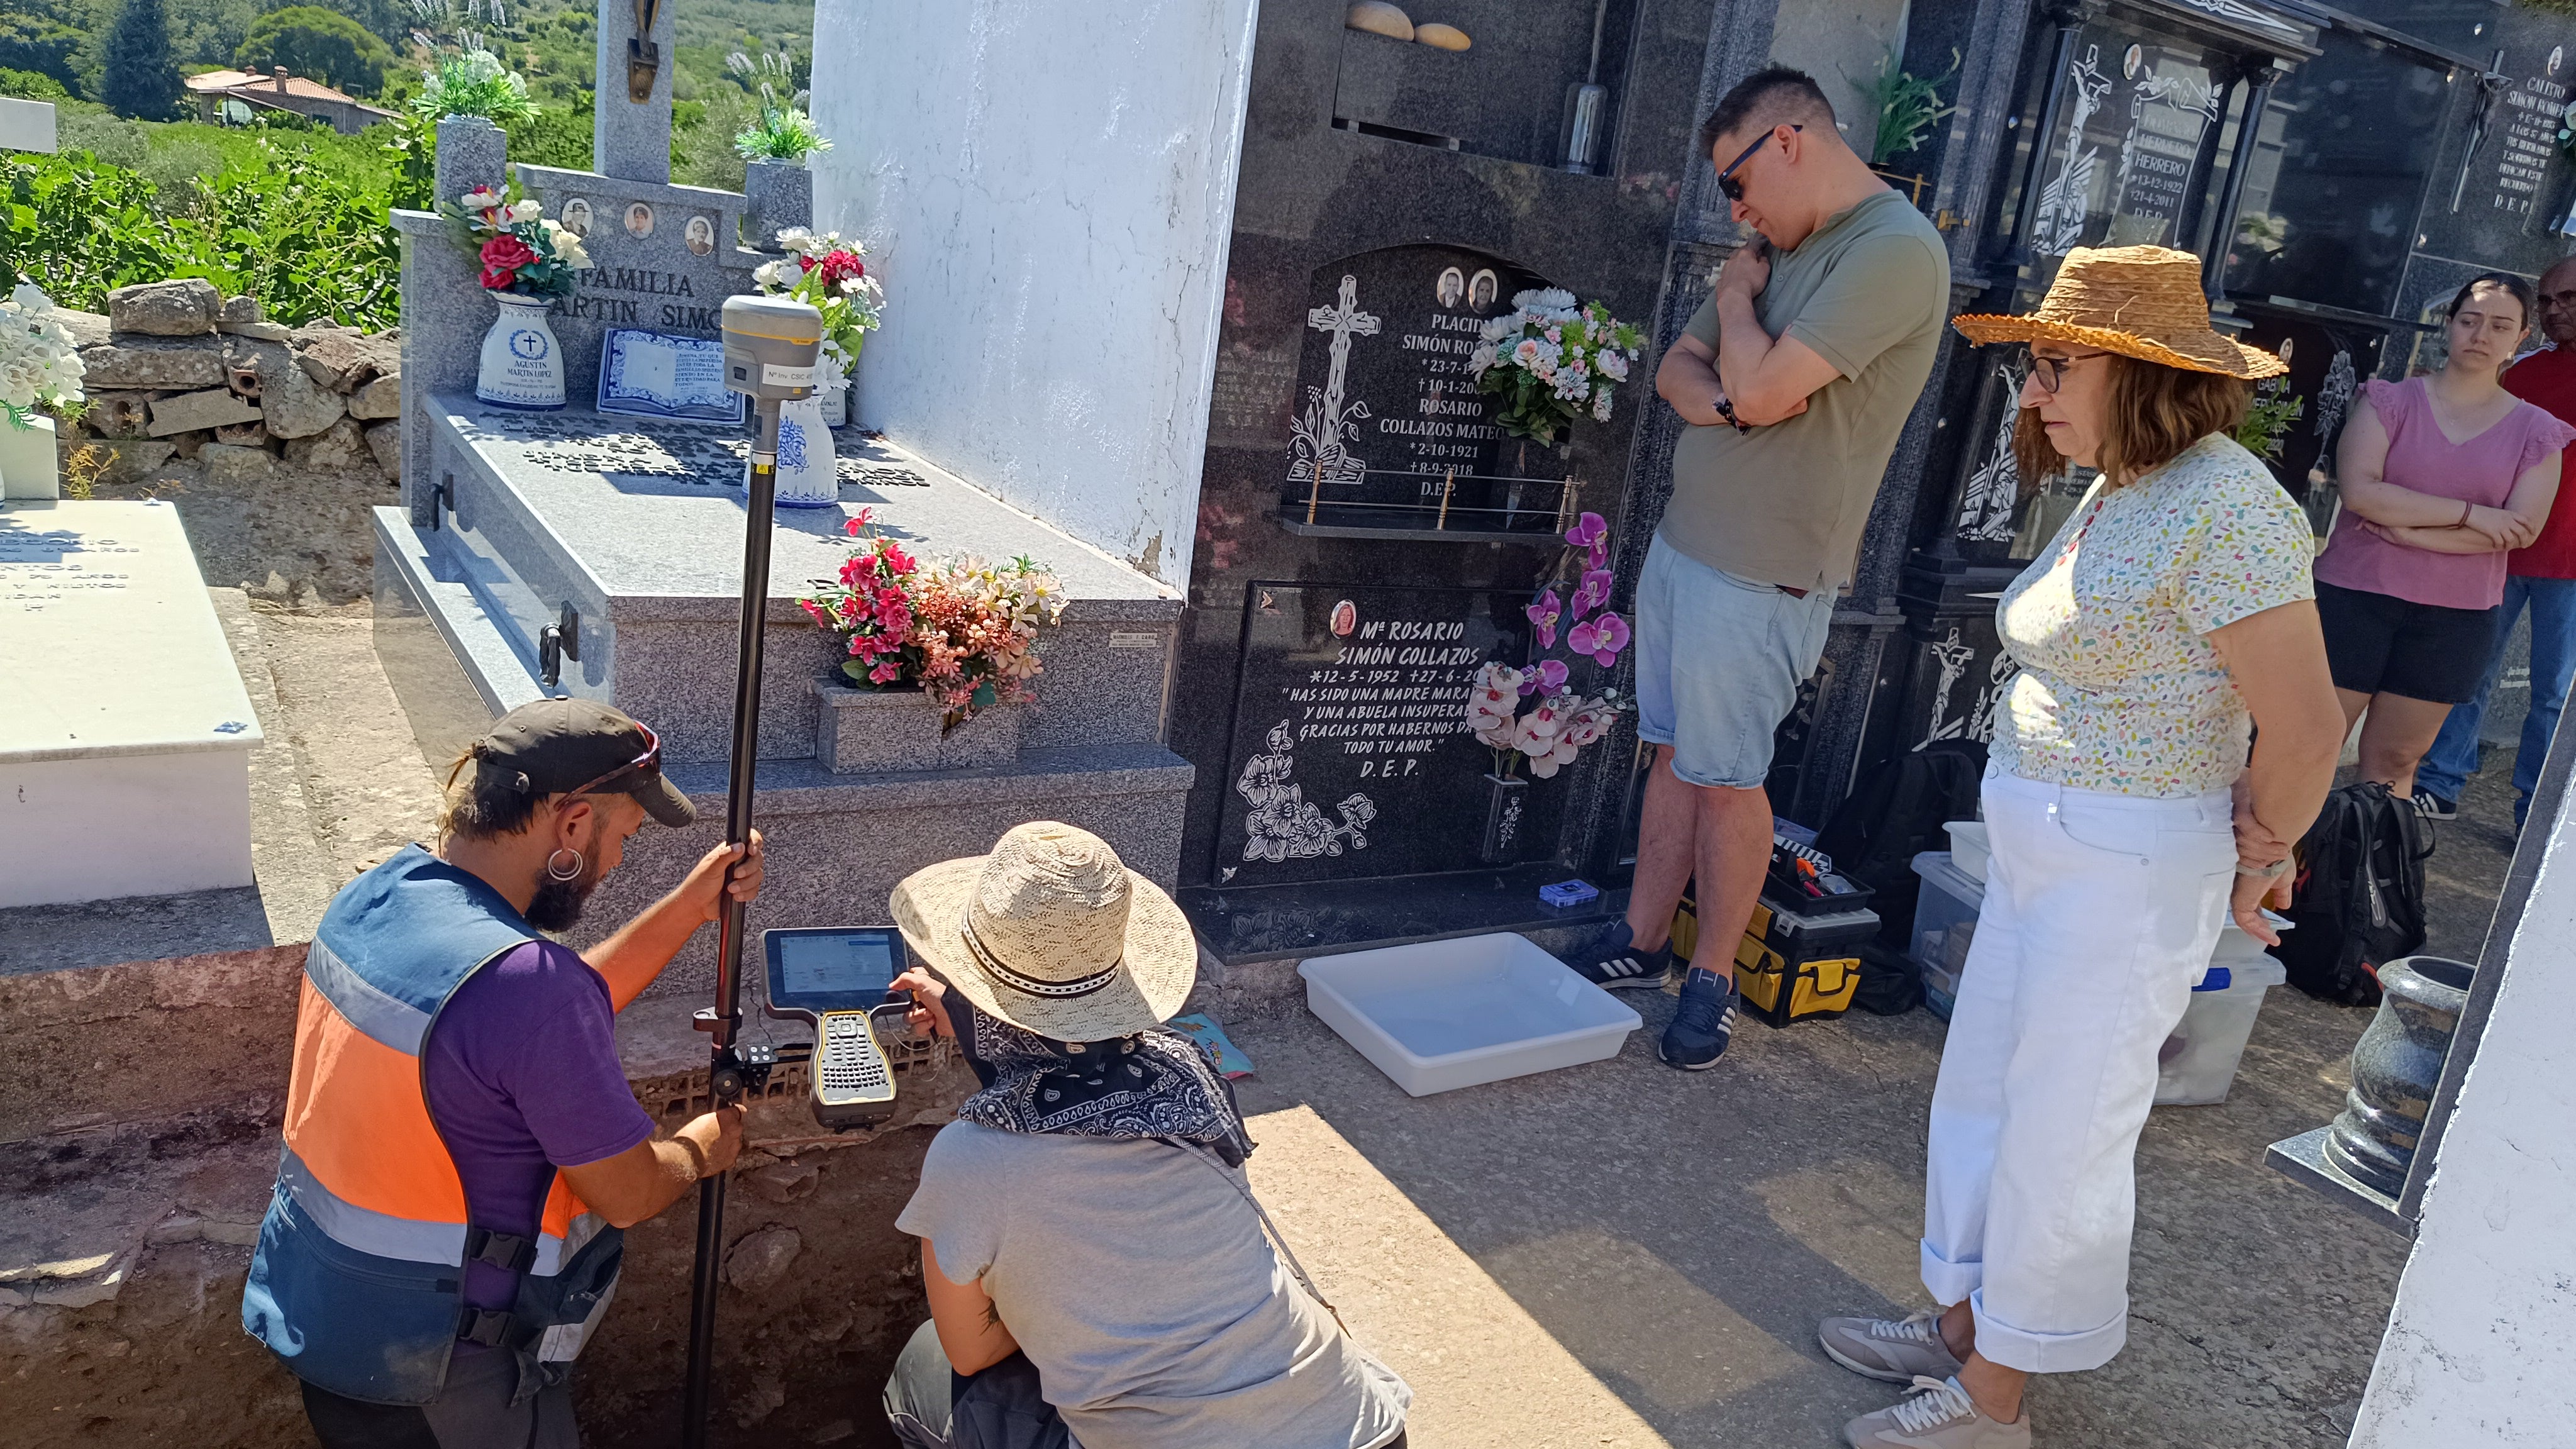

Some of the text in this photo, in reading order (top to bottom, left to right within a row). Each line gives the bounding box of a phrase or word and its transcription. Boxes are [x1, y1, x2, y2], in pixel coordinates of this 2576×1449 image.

[2135, 153, 2186, 177] HERRERO
[580, 266, 695, 297] FAMILIA
[550, 293, 722, 331] ARTIN SIMO
[1431, 314, 1483, 333] PLACID
[1402, 333, 1477, 355] SIMÓN RO
[508, 368, 535, 377] MARTIN
[514, 360, 547, 369] AGUSTIN
[1430, 359, 1470, 375] 23-7-1
[1428, 379, 1479, 394] 10-1-20
[2258, 377, 2290, 394] GABA
[1419, 398, 1482, 416] ROSARIO
[1380, 418, 1507, 440] COLLAZOS MATEO
[1389, 621, 1463, 640] ROSARIO
[1335, 642, 1479, 665] SIMÓN COLLAZOS
[1319, 689, 1349, 701] SIDO
[1352, 687, 1379, 701] UNA
[1382, 687, 1430, 701] MADRE
[1431, 687, 1475, 700] MARA
[1304, 706, 1315, 719] Y
[1316, 706, 1345, 719] UNA
[1346, 705, 1397, 719] ABUELA
[1300, 721, 1472, 741] GRACIAS POR HABERNOS DA
[1344, 741, 1374, 754] TODO
[1378, 740, 1394, 753] TU
